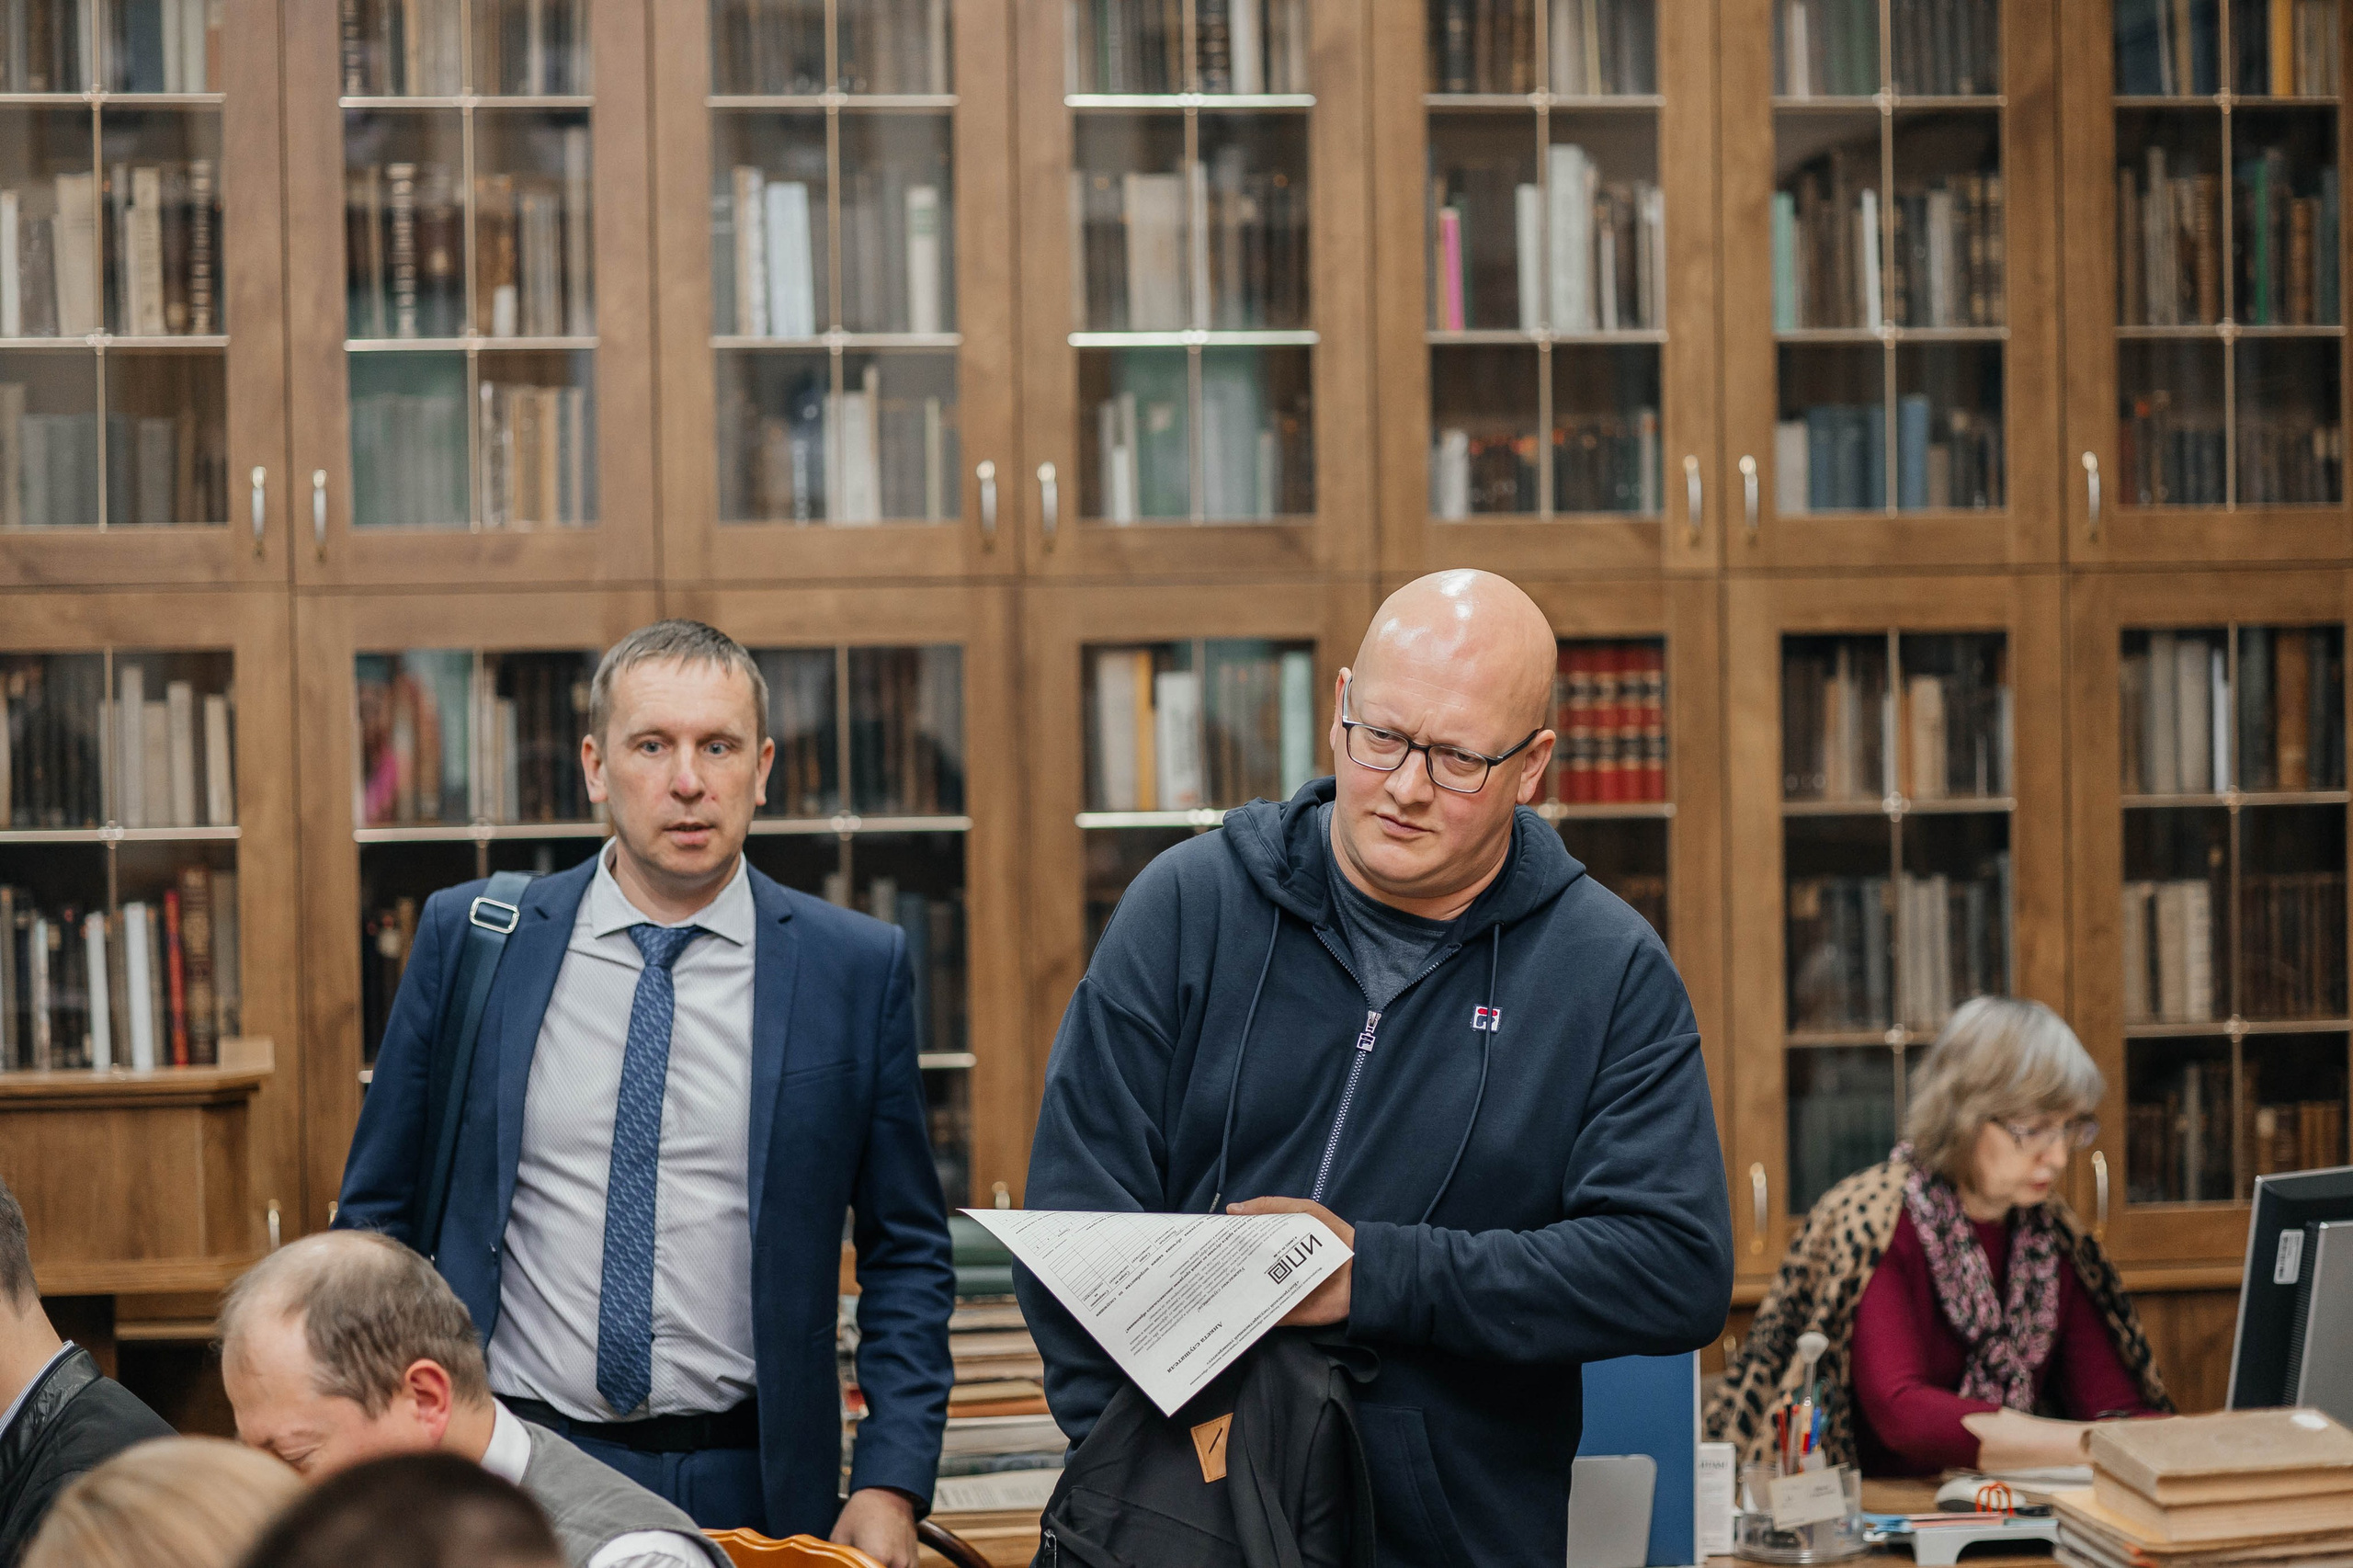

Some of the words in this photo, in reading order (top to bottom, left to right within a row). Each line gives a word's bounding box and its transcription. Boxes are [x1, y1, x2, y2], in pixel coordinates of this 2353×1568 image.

[1221, 1266, 1246, 1290] Уважаемые
[1199, 1321, 1223, 1344] Анкета
[1166, 1342, 1201, 1374] слушателя
